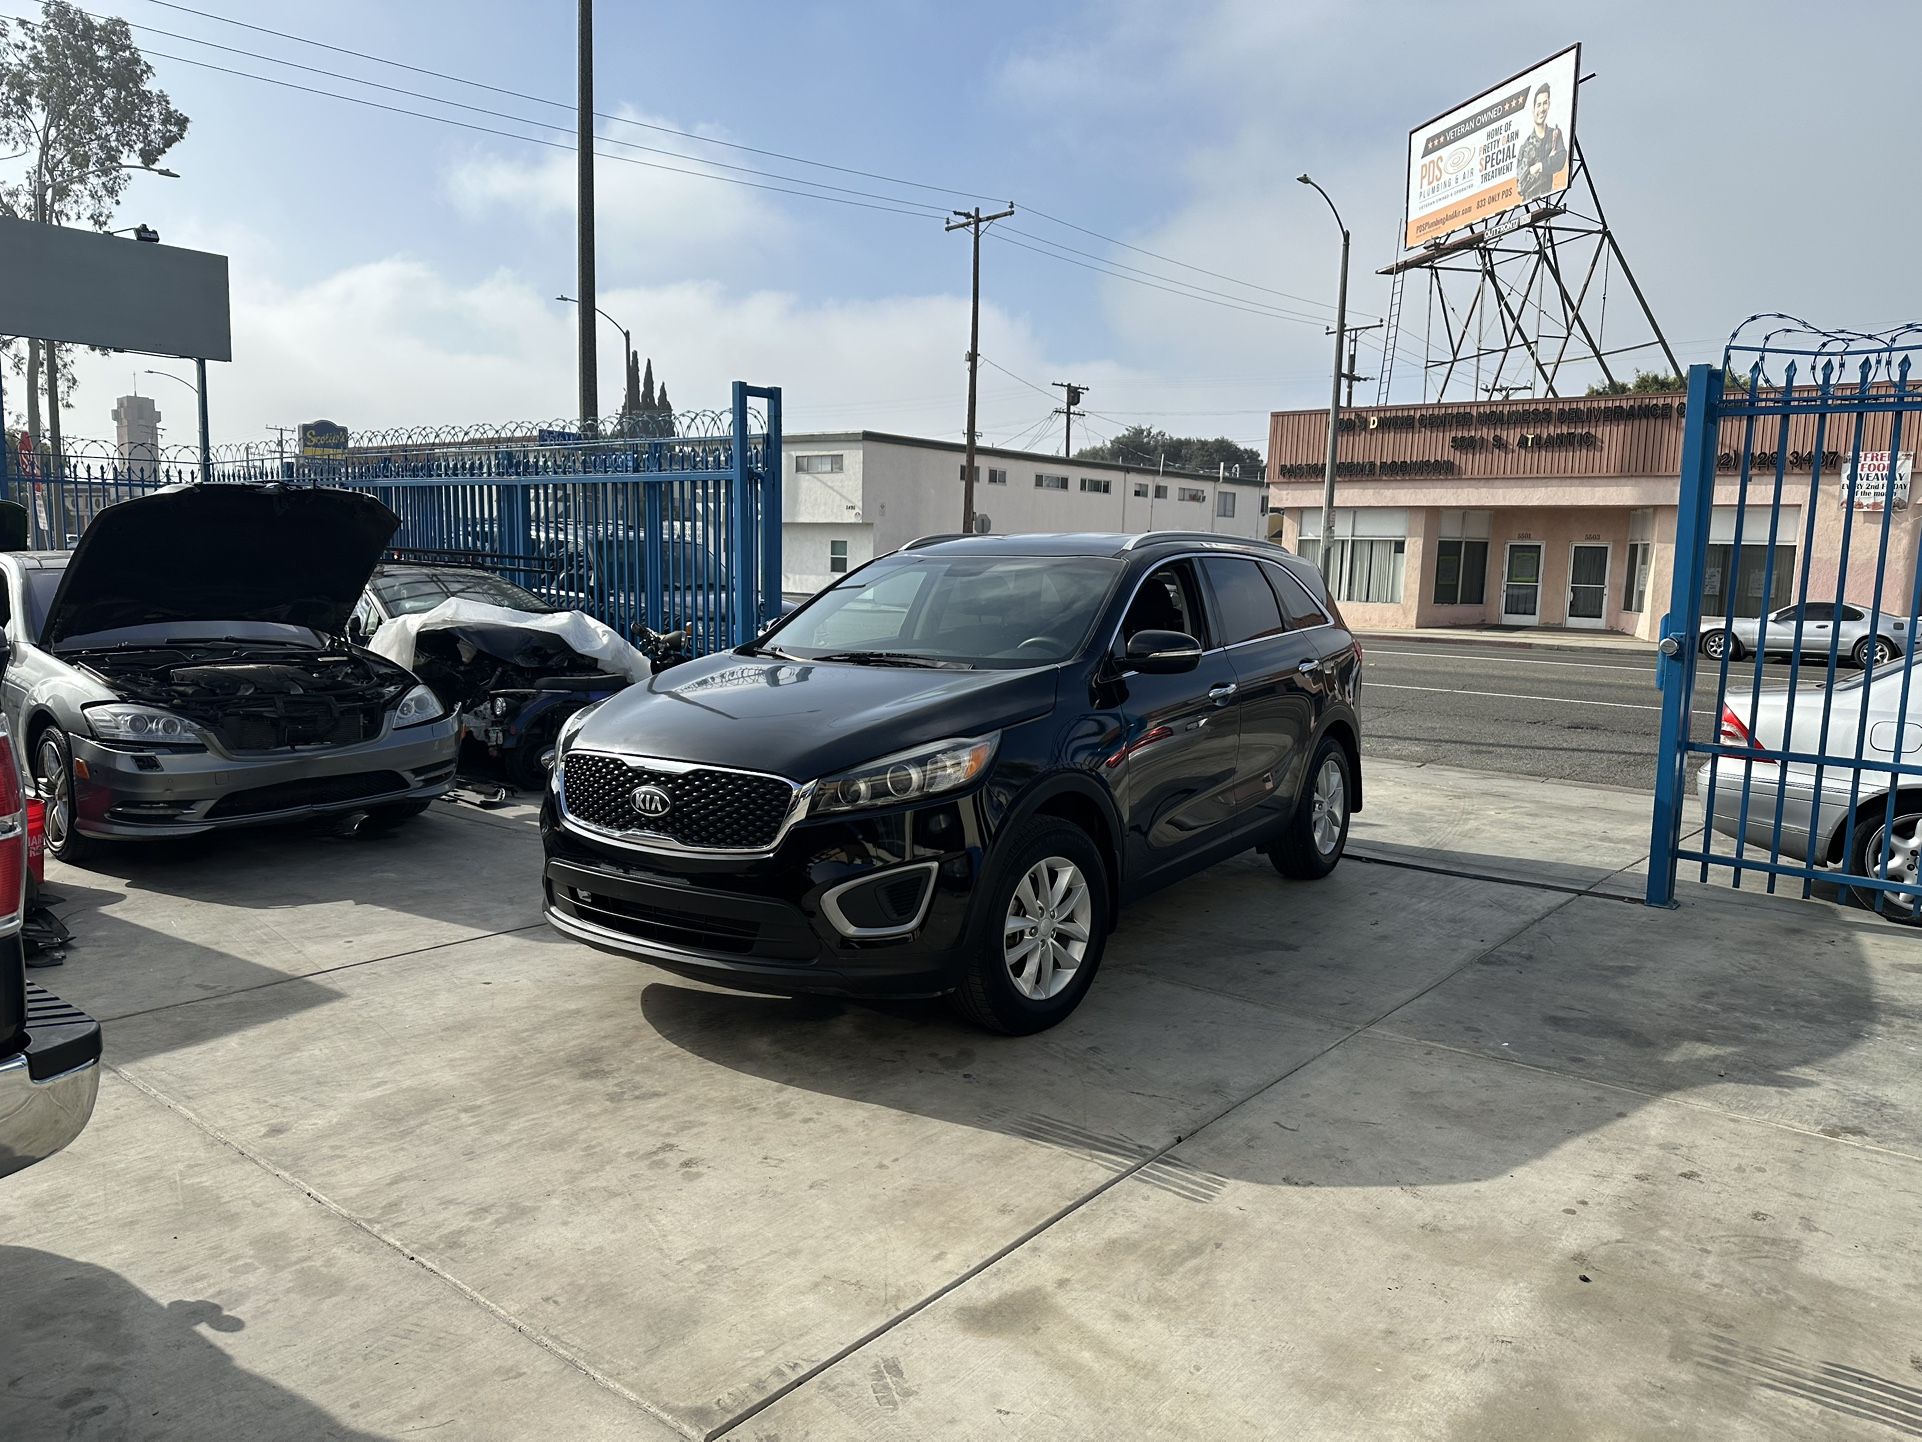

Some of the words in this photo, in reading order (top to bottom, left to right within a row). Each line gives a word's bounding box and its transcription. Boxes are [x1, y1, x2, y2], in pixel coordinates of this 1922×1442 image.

[1445, 120, 1475, 141] VETERAN
[1475, 105, 1503, 126] OWNED
[1486, 125, 1503, 141] HOME
[1504, 120, 1512, 133] OF
[1479, 138, 1501, 157] PRETTY
[1502, 129, 1519, 146] DARN
[1479, 143, 1516, 173] SPECIAL
[1419, 178, 1451, 200] PLUMBING
[1462, 167, 1474, 180] AIR
[1420, 155, 1443, 190] PDS
[1481, 161, 1513, 184] TREATMENT
[1488, 192, 1501, 205] ONLY
[1501, 187, 1513, 199] PDS
[1328, 411, 1366, 431] OD'S
[1369, 414, 1415, 430] DIVINE
[1418, 411, 1472, 428] CENTER
[1477, 407, 1551, 426] HOLINESS
[1557, 403, 1672, 424] DELIVERANCE
[1516, 431, 1594, 449] ATLANTIC
[1379, 459, 1453, 475] ROBINSON
[1860, 462, 1890, 472] FOO
[1863, 452, 1891, 462] FRE
[635, 793, 663, 812] KIA
